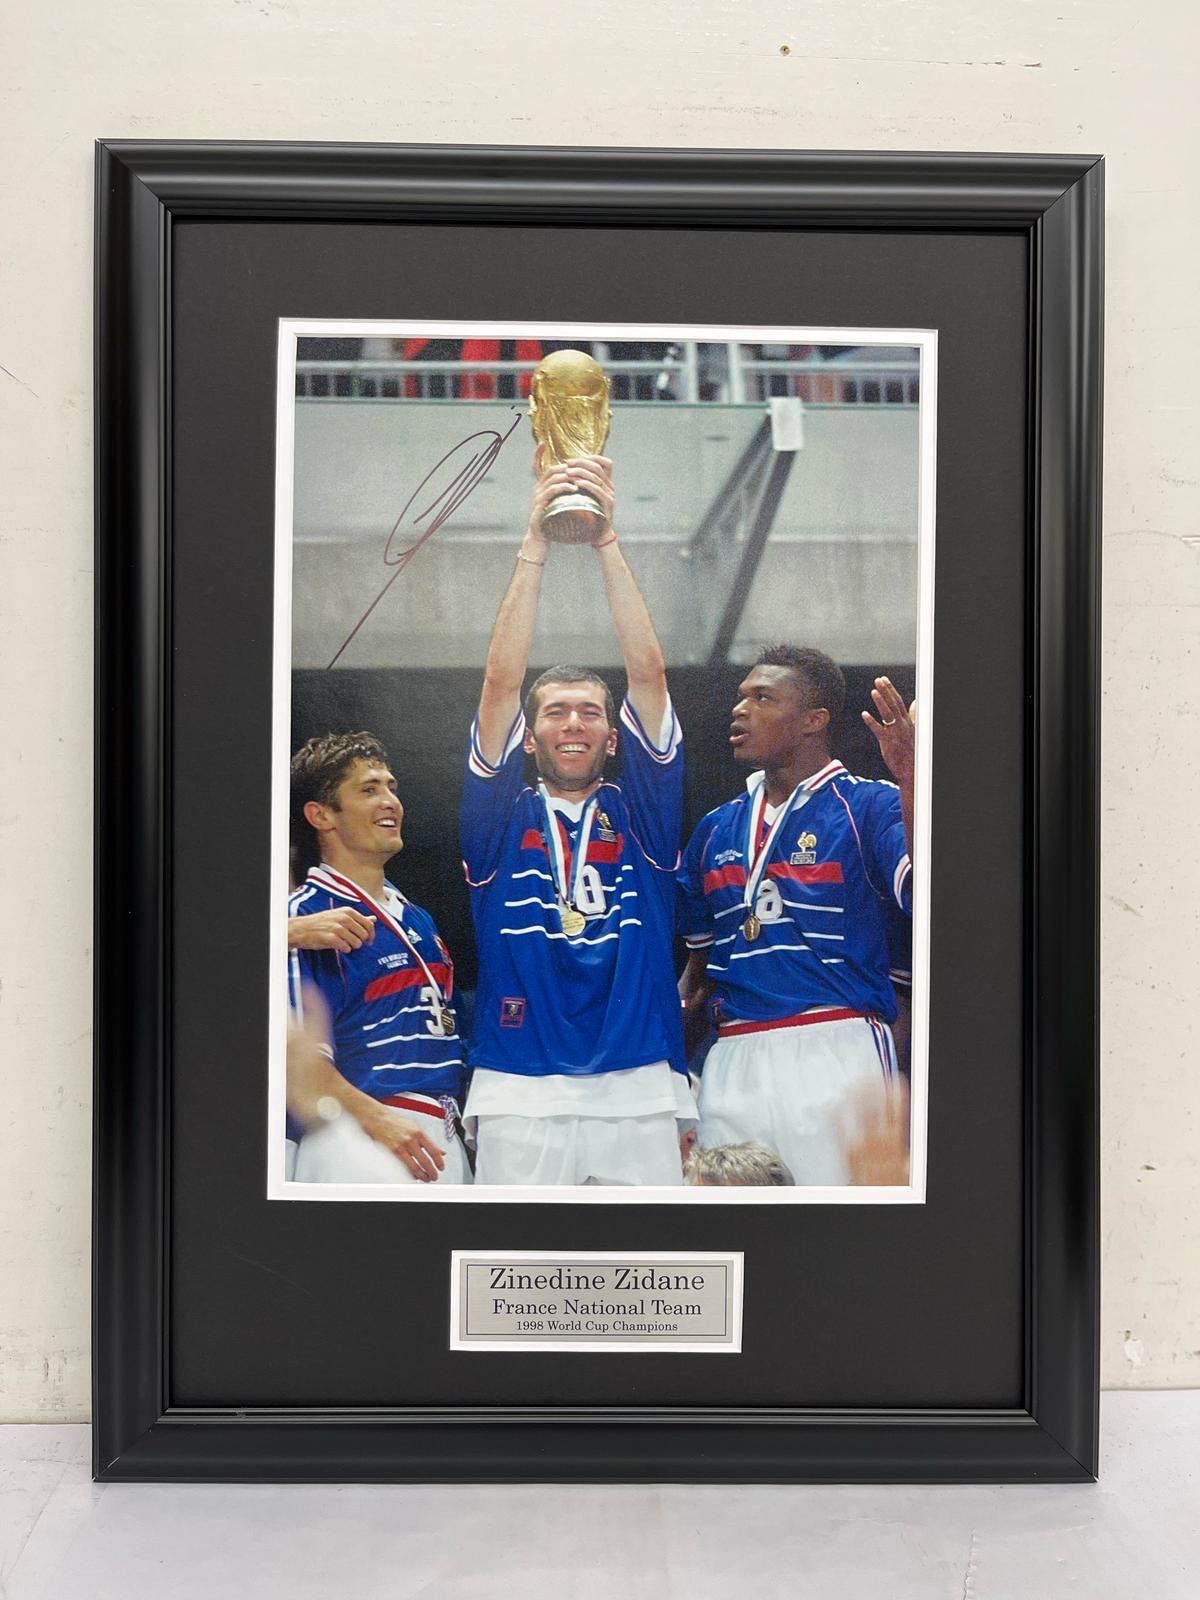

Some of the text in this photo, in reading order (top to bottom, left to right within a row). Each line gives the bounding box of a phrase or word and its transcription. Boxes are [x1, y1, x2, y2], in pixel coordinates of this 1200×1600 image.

[420, 986, 446, 1036] 3
[489, 1267, 705, 1291] Zinedine Zidane
[492, 1299, 702, 1316] France National Team
[516, 1321, 678, 1334] 1998 World Cup Champions
